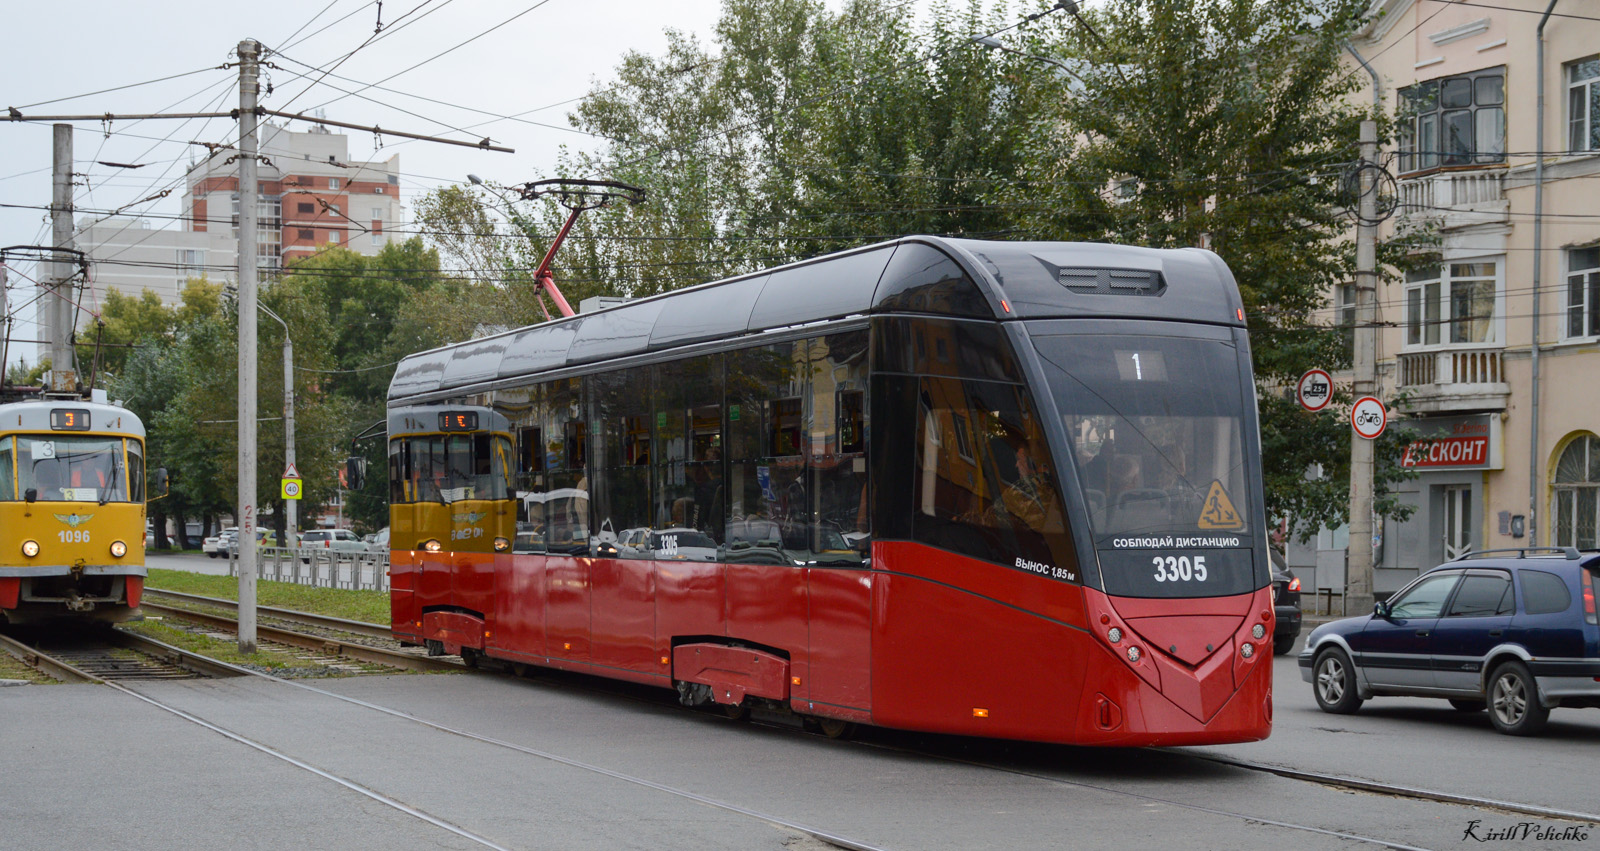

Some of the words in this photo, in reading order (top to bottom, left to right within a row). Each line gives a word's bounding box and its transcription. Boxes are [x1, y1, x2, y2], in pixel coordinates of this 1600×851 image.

[1131, 353, 1142, 380] 1
[65, 412, 74, 426] 3
[42, 443, 54, 457] 3
[66, 490, 74, 501] 3
[57, 530, 90, 543] 1096
[1113, 536, 1174, 549] СОБЛЮДАЙ
[1175, 537, 1240, 549] ДИСТАНЦИЮ
[660, 534, 678, 556] 3305
[1015, 557, 1050, 575] ВЫНОС
[1152, 555, 1208, 583] 3305
